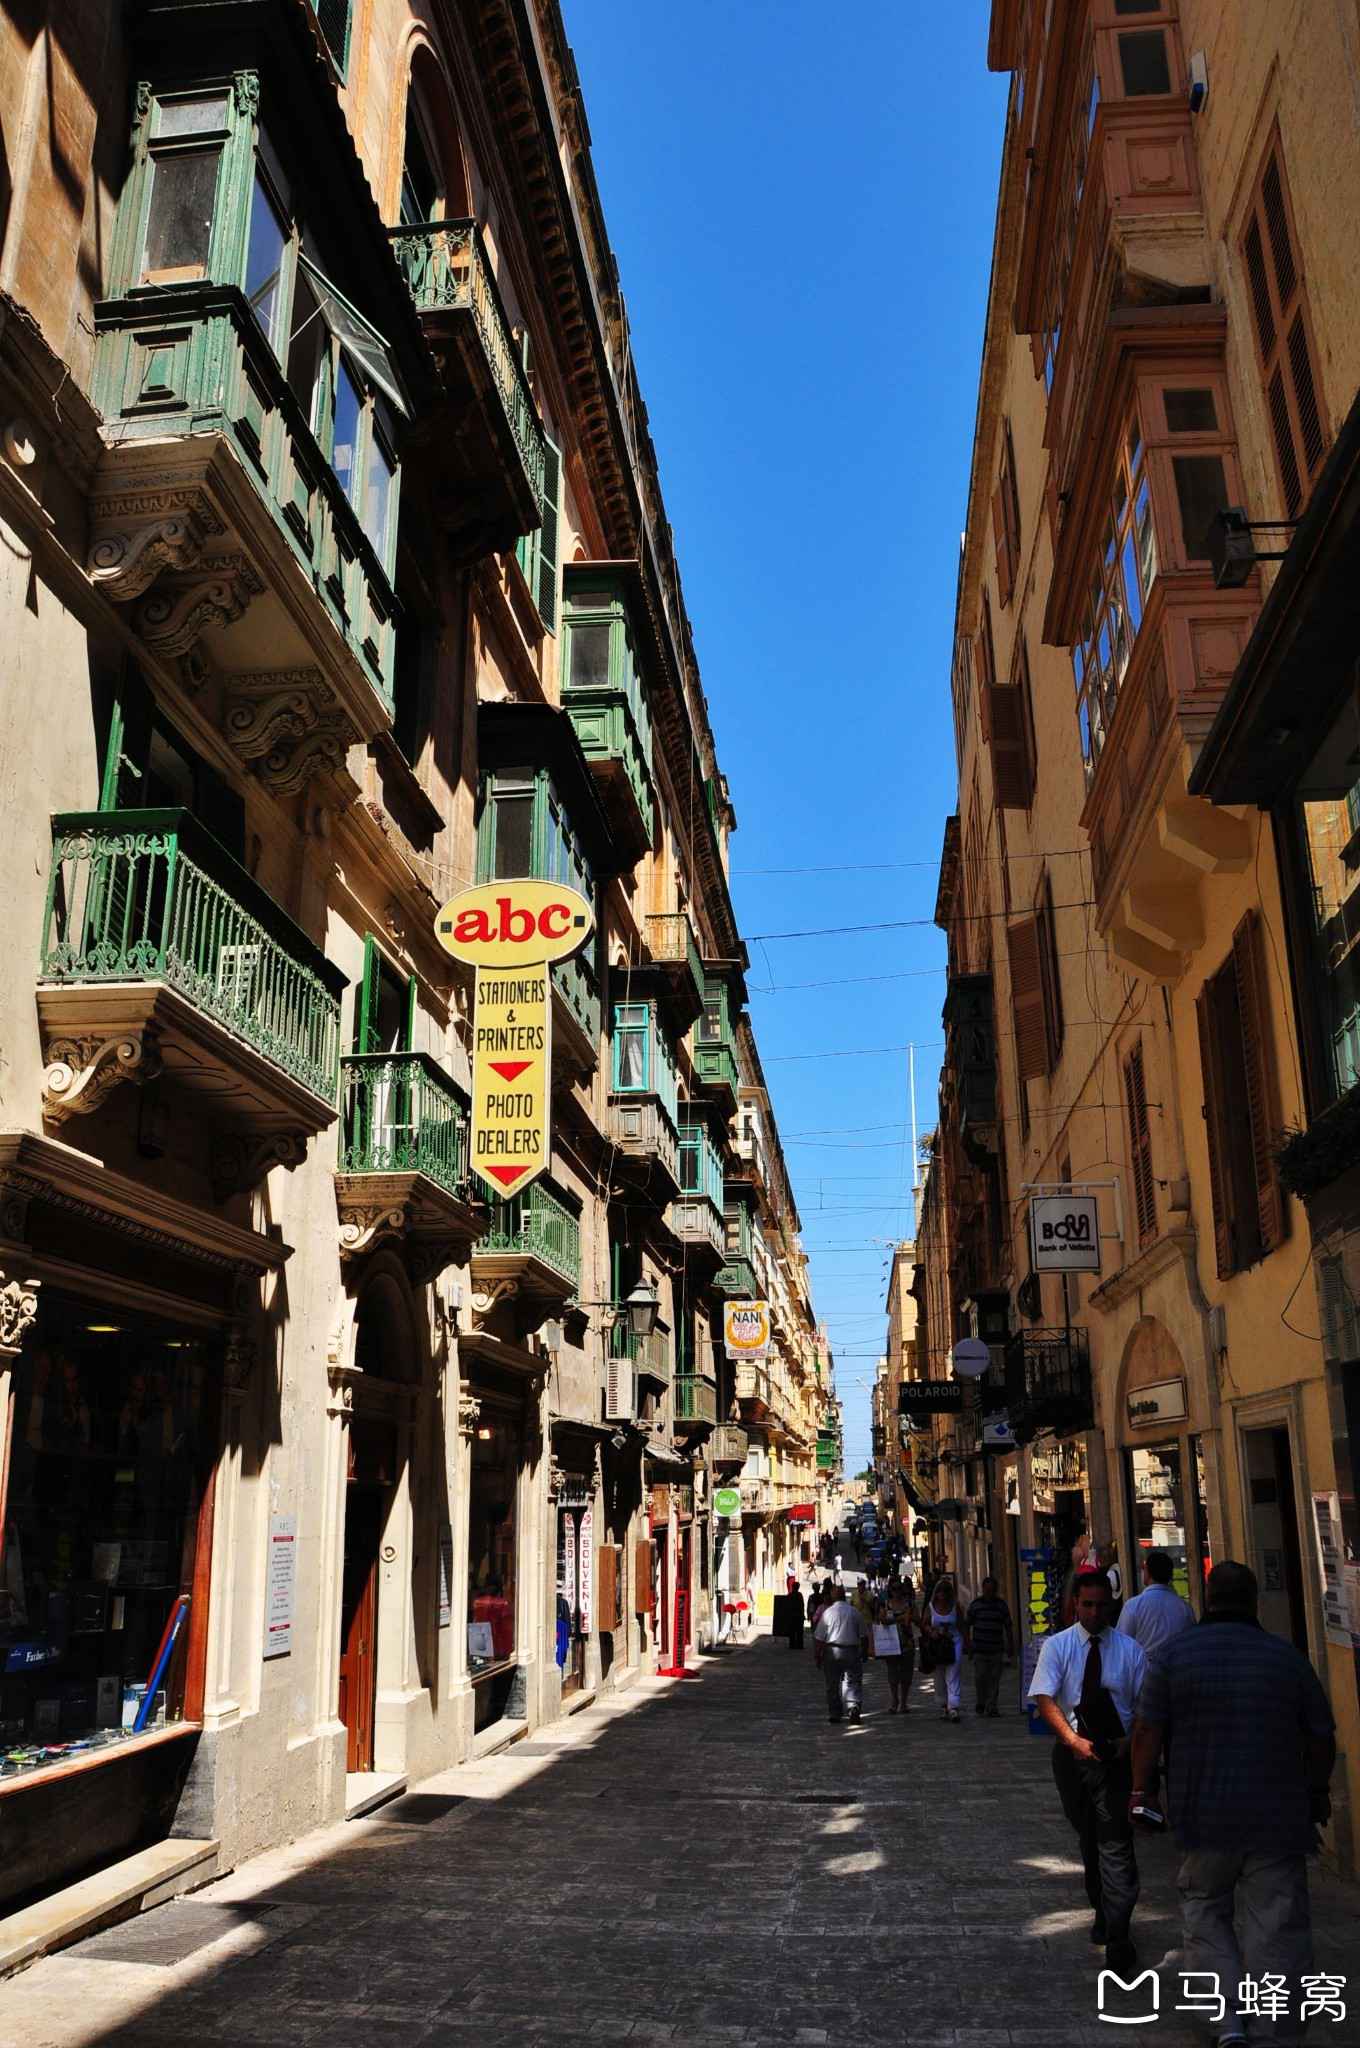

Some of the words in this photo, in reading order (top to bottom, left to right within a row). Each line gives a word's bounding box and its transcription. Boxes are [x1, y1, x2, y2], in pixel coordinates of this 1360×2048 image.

[453, 897, 572, 943] abc
[478, 978, 545, 1005] STATIONERS
[506, 1010, 516, 1022] &
[477, 1026, 544, 1052] PRINTERS
[486, 1093, 533, 1119] PHOTO
[477, 1129, 541, 1155] DEALERS
[1038, 1244, 1056, 1252] Bank
[901, 1385, 961, 1398] POLAROID
